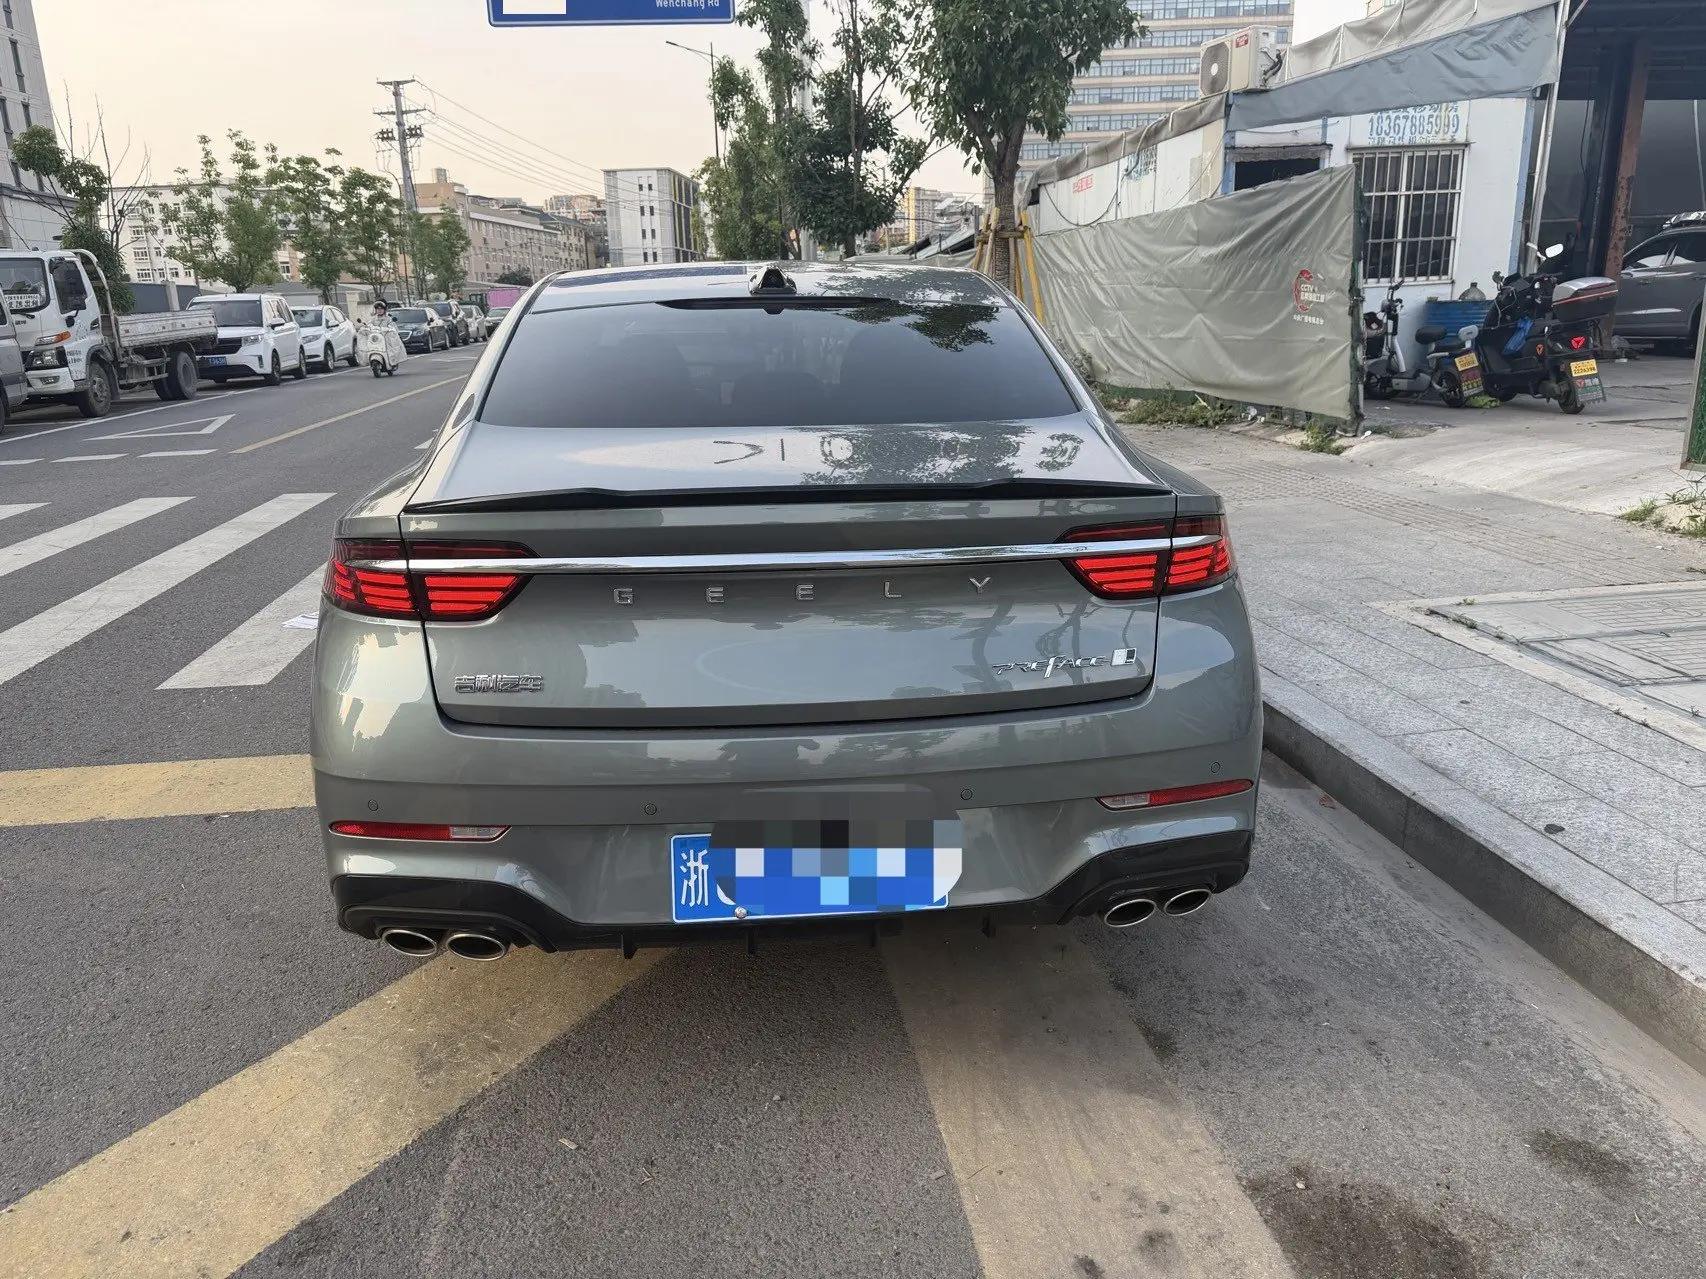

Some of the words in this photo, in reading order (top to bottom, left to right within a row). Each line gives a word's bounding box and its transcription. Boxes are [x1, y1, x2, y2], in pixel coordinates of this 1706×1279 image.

[655, 0, 705, 10] Wenchang
[613, 576, 992, 605] GEELY
[453, 673, 544, 693] 吉利汽车
